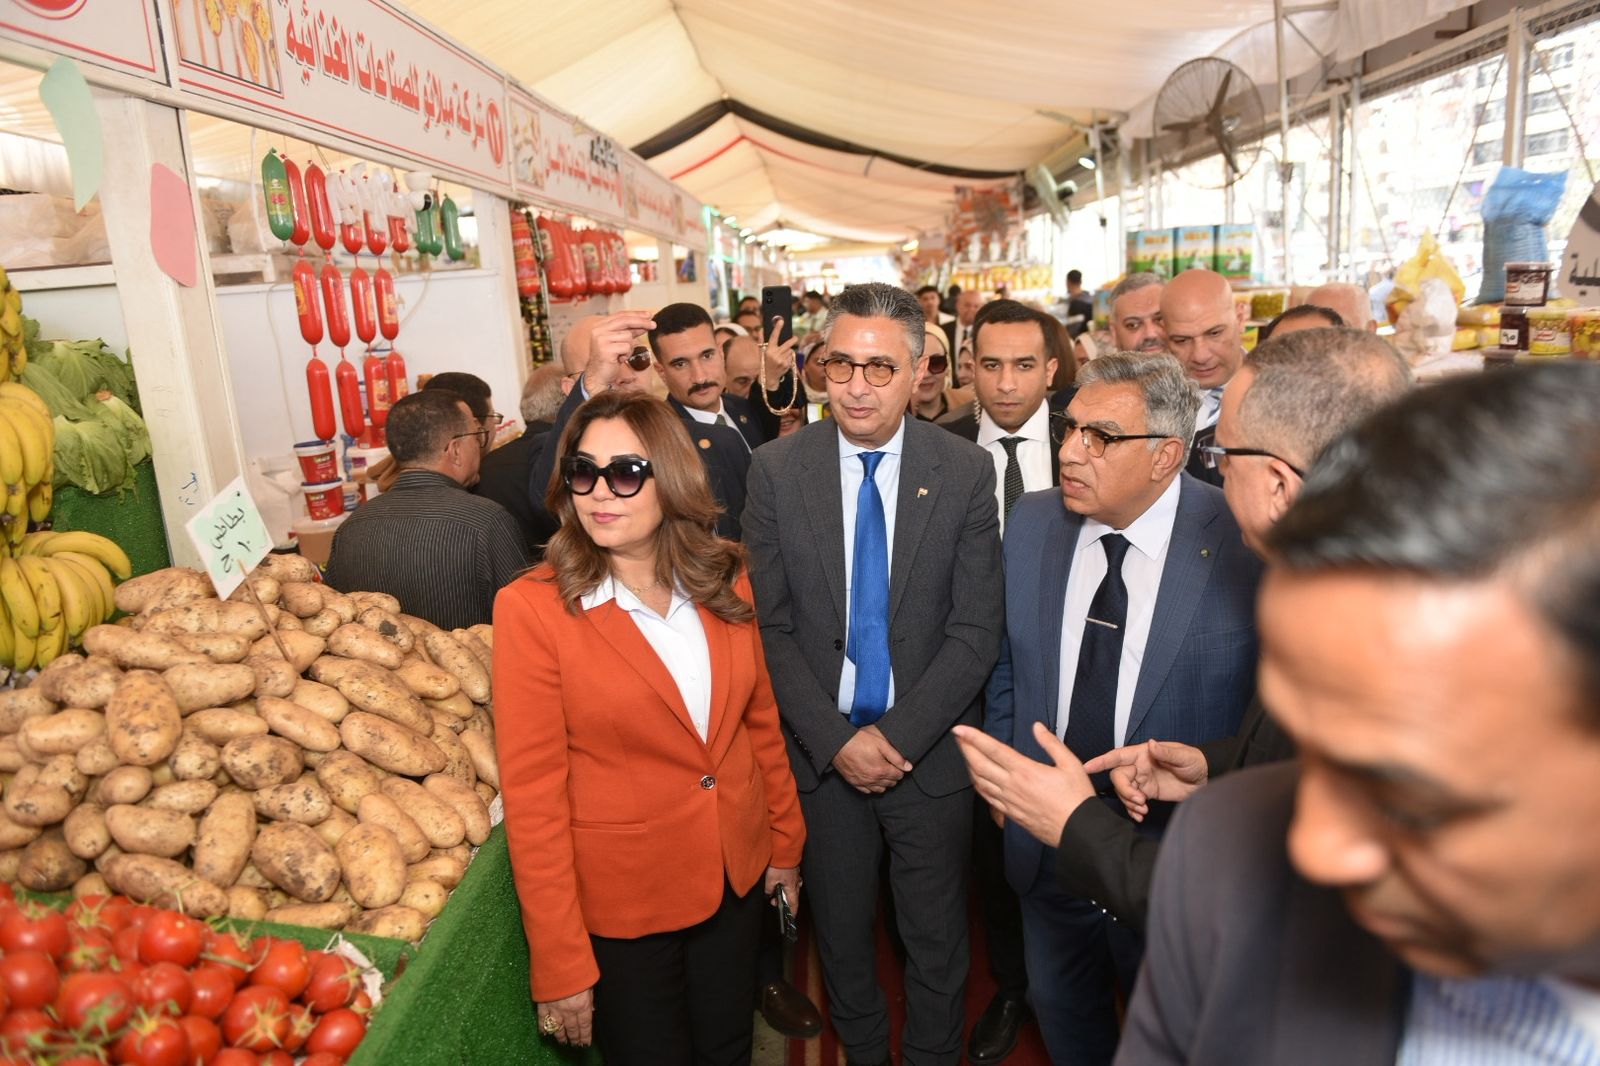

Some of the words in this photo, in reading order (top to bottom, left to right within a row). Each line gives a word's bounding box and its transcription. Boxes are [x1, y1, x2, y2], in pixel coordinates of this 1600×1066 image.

[277, 0, 354, 85] الغذائية
[355, 31, 420, 113] للصناعات
[453, 82, 486, 148] شركة
[1569, 253, 1600, 296] لية
[212, 508, 246, 549] بطاطس
